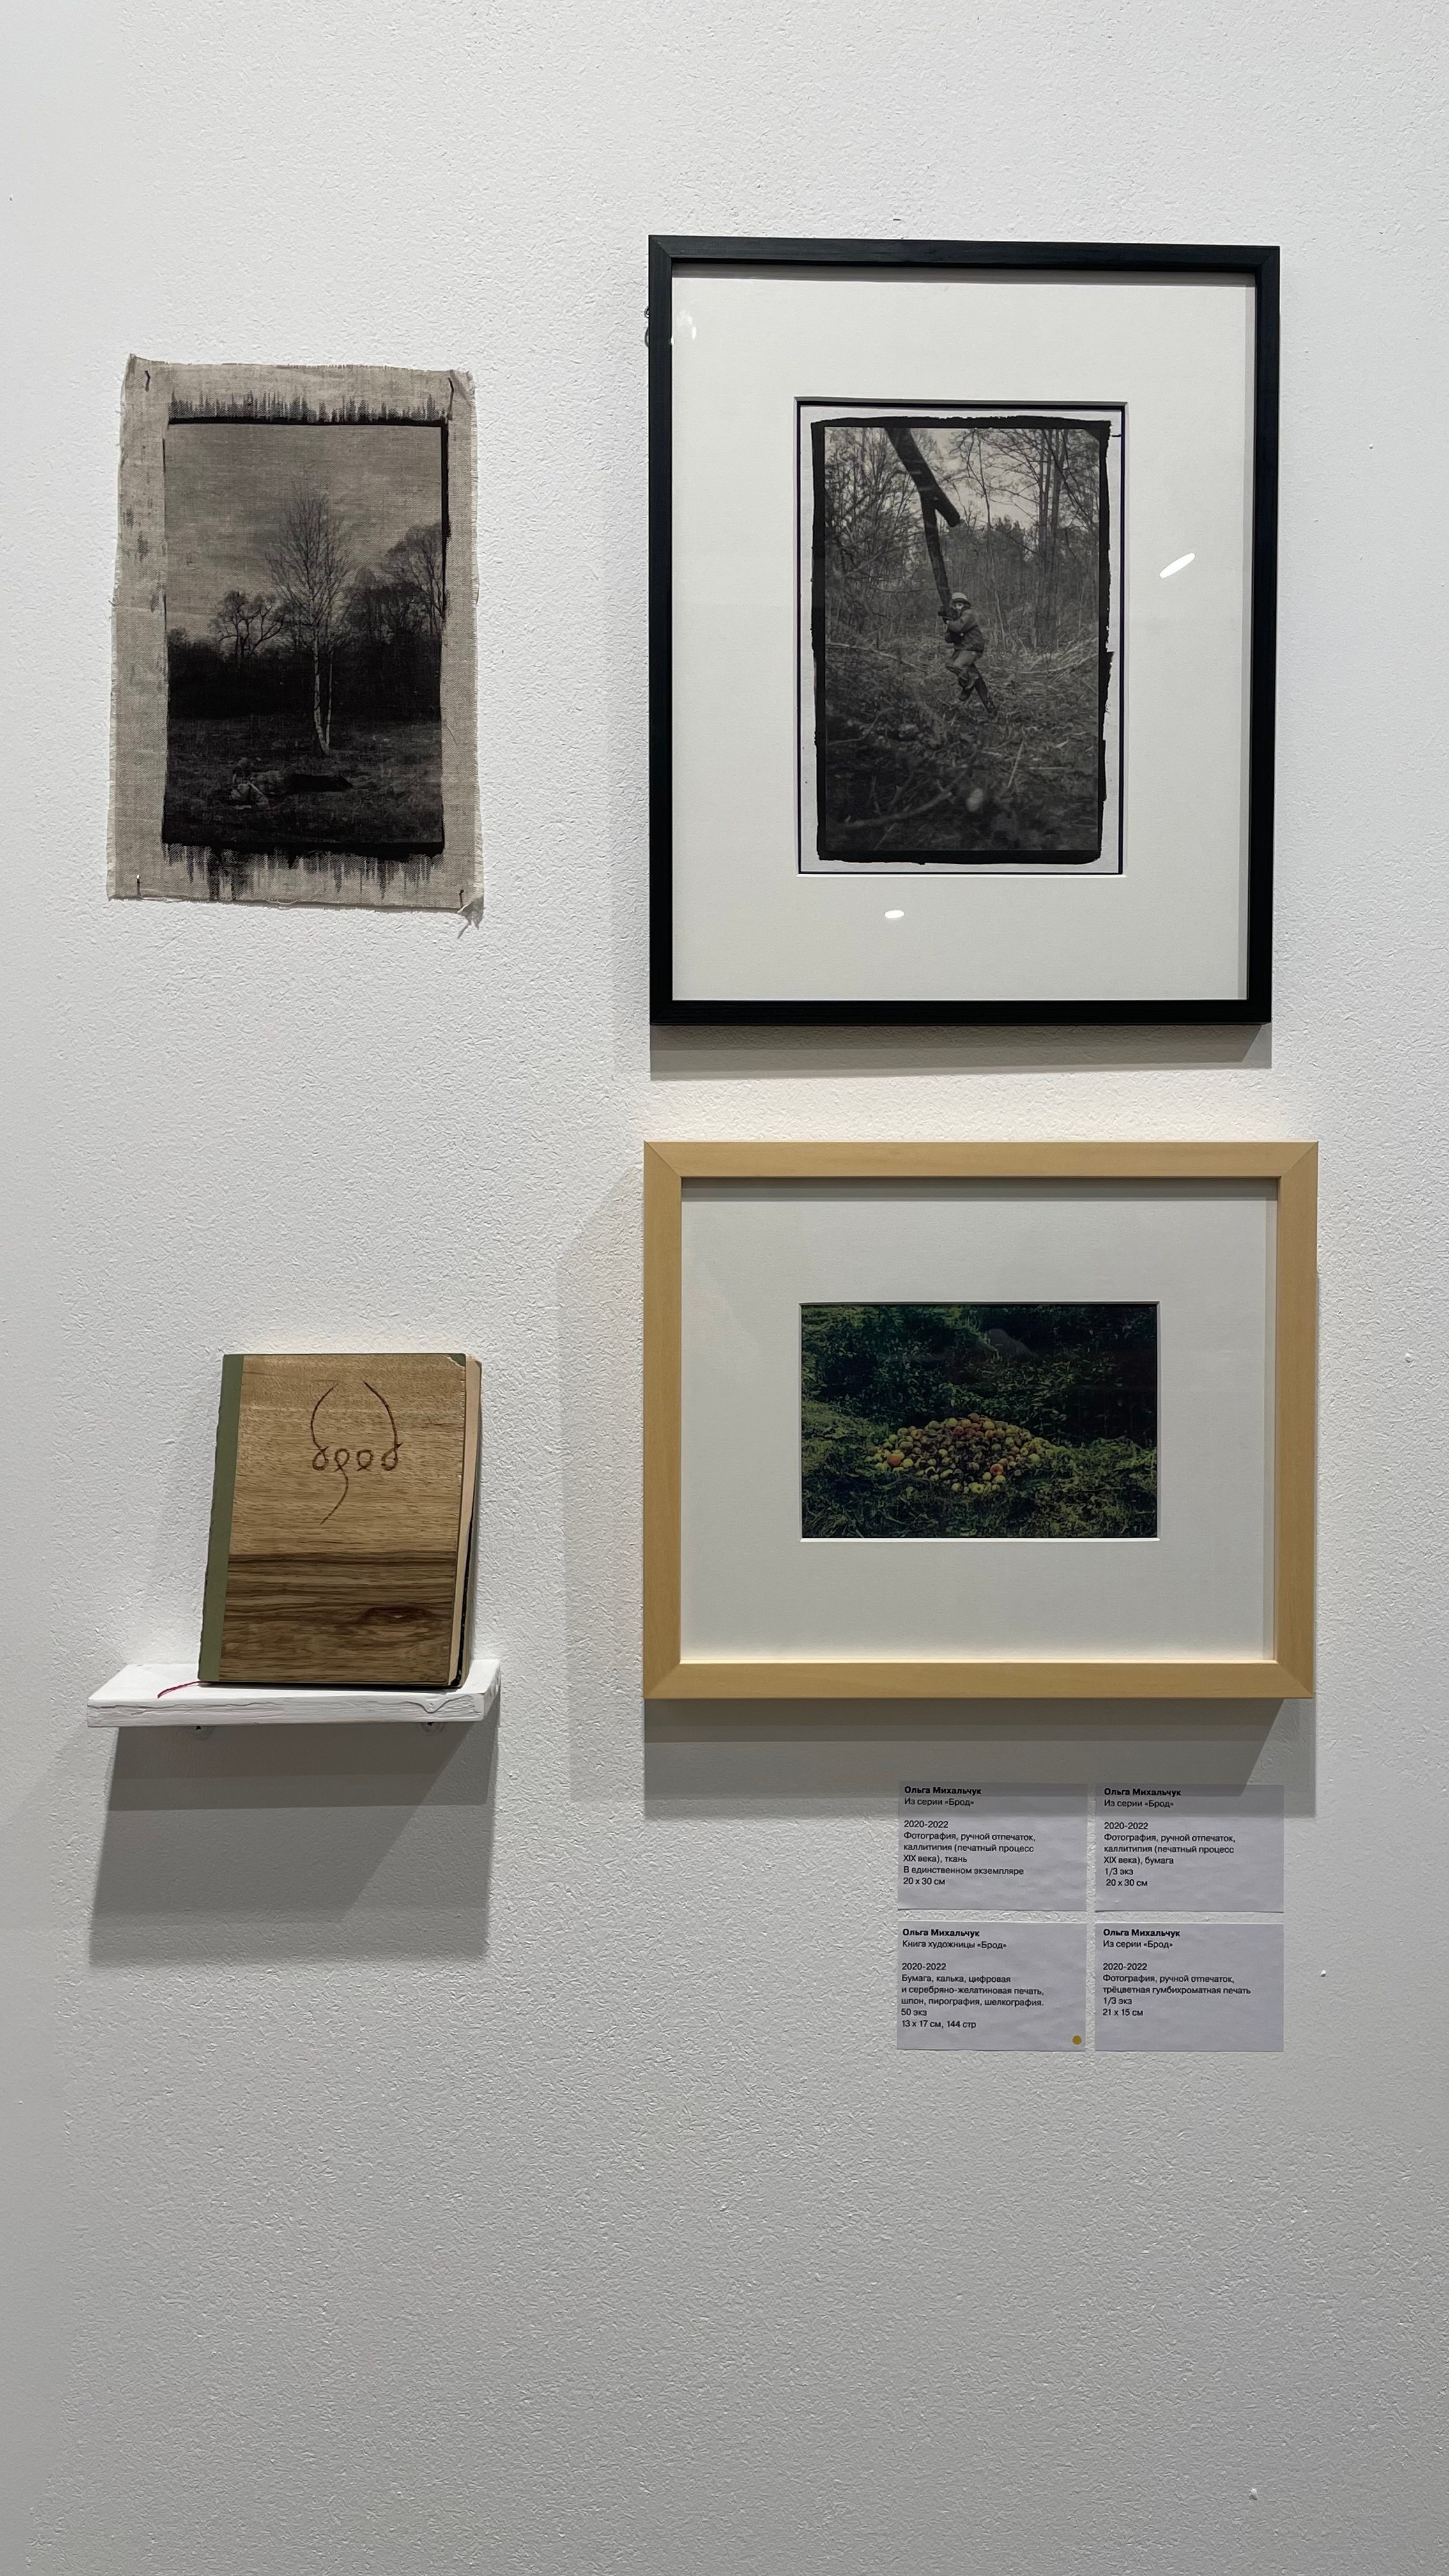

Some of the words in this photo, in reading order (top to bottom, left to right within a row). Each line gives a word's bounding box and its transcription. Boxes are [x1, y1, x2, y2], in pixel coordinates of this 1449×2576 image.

[904, 1786, 931, 1794] Ольга
[932, 1786, 983, 1797] Михальчук
[1103, 1788, 1131, 1796] Ольга
[1131, 1788, 1182, 1798] Михальчук
[904, 1797, 916, 1805] Из
[944, 1798, 975, 1807] «Брод»
[1117, 1800, 1144, 1809] серии
[1144, 1799, 1175, 1809] «Брод»
[903, 1820, 949, 1828] 2020-2022
[1103, 1821, 1149, 1830] 2020-2022
[903, 1831, 960, 1841] Фотография,
[960, 1832, 991, 1842] ручной
[991, 1834, 1036, 1843] отпечаток,
[1103, 1833, 1160, 1843] Фотография,
[1160, 1834, 1191, 1843] ручной
[1191, 1835, 1237, 1843] отпечаток,
[954, 1843, 997, 1853] (печатный
[1154, 1844, 1198, 1855] (печатный
[1199, 1846, 1235, 1855] процесс
[917, 1854, 944, 1864] века),
[1118, 1856, 1144, 1866] века),
[1144, 1856, 1175, 1866] бумага
[973, 1868, 1025, 1876] экземпляре
[1105, 1867, 1119, 1877] 1/3
[903, 1876, 914, 1885] 20
[921, 1877, 933, 1885] 30
[1105, 1878, 1117, 1887] 20
[1124, 1878, 1135, 1887] 30
[902, 1928, 930, 1936] Ольга
[930, 1928, 981, 1938] Михальчук
[1103, 1928, 1130, 1936] Ольга
[1131, 1928, 1181, 1938] Михальчук
[902, 1940, 927, 1948] Книга
[928, 1942, 976, 1950] художницы
[977, 1940, 1008, 1950] «Брод»
[1103, 1940, 1115, 1948] Из
[1116, 1941, 1142, 1950] серии
[1143, 1940, 1174, 1949] «Брод»
[901, 1962, 947, 1971] 2020-2022
[1103, 1962, 1149, 1971] 2020-2022
[901, 1974, 935, 1984] Бумага,
[936, 1975, 967, 1984] калька,
[968, 1975, 1012, 1984] цифровая
[1103, 1974, 1158, 1984] Фотография,
[1159, 1974, 1190, 1984] ручной
[908, 1985, 1013, 1995] серебряно-желатиновая
[1013, 1988, 1045, 1997] печать,
[1152, 1985, 1222, 1996] гумбихроматная
[901, 1998, 927, 2006] шпон,
[928, 1997, 983, 2007] пирография,
[1103, 1997, 1117, 2006] 1/3
[901, 2007, 912, 2016] 50
[1102, 2008, 1112, 2016] 21
[1121, 2008, 1131, 2016] 15
[901, 2019, 911, 2028] 13
[919, 2020, 928, 2028] 17
[947, 2020, 962, 2028] 144
[962, 2021, 977, 2030] стр
